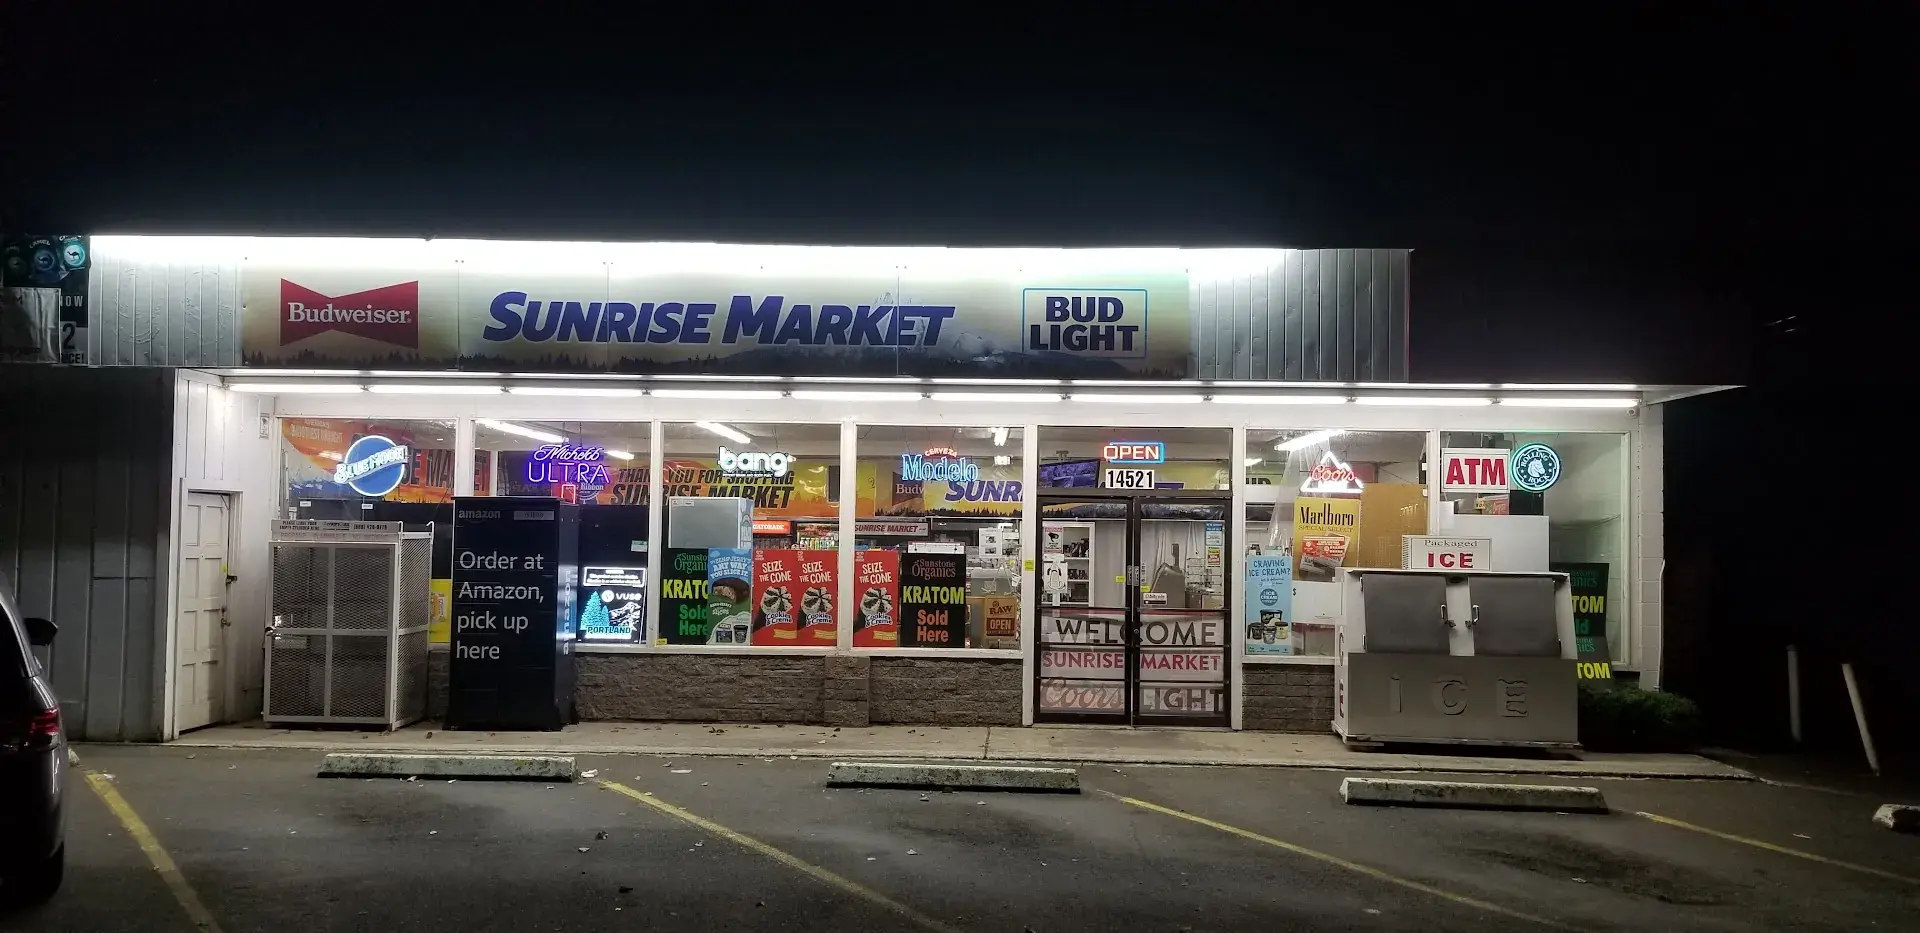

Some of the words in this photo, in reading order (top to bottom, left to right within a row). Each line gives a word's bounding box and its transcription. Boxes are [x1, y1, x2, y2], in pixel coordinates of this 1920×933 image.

[60, 296, 83, 307] OW
[1045, 296, 1124, 323] BUD
[287, 302, 409, 325] Budweiser
[483, 291, 717, 344] SUNRISE
[721, 295, 956, 347] MARKET
[1030, 324, 1139, 351] LIGHT
[924, 447, 958, 458] CERVEZA
[1103, 445, 1160, 460] OPEN
[1520, 451, 1549, 468] ROLLING
[718, 446, 788, 478] bang
[901, 454, 979, 482] Modelo
[334, 460, 371, 484] BLUE
[528, 462, 610, 484] ULTRA
[698, 469, 724, 484] FOR
[1107, 470, 1153, 488] 14521
[1312, 464, 1357, 481] Coors
[1445, 458, 1506, 486] ATM
[1528, 474, 1550, 483] ROCK
[458, 509, 500, 519] amazon
[1300, 503, 1354, 527] Marlboro
[887, 525, 919, 533] MARKET
[1424, 539, 1478, 548] Packaged
[459, 551, 518, 570] Order
[523, 554, 544, 570] at
[713, 562, 730, 572] ANY
[730, 561, 748, 570] WAY
[762, 560, 784, 573] SEIZE
[802, 561, 824, 574] SEIZE
[862, 562, 884, 574] SEIZE
[919, 558, 956, 568] Sunstone
[1253, 559, 1285, 568] CRAVING
[1427, 552, 1474, 569] ICE
[759, 573, 770, 582] THE
[770, 571, 793, 584] CONE
[799, 575, 810, 583] THE
[810, 571, 832, 584] CONE
[859, 575, 869, 584] THE
[870, 572, 893, 584] CONE
[912, 564, 956, 580] Organics
[1262, 568, 1291, 576] CREAM?
[458, 581, 545, 604] Amazon,
[903, 585, 965, 605] KRATOM
[917, 609, 949, 626] Sold
[989, 605, 1013, 615] RAW
[457, 611, 497, 633] pick
[503, 615, 529, 633] up
[587, 626, 631, 634] PORTLAND
[989, 619, 1012, 630] OPEN
[917, 625, 949, 643] Here
[1055, 619, 1217, 646] WELCOME
[456, 640, 500, 660] here
[1042, 652, 1124, 668] SUNRISE
[1140, 653, 1221, 671] MARKET
[1040, 677, 1123, 709] Coors
[1141, 687, 1225, 714] LIGHT
[1388, 672, 1529, 718] ICE
